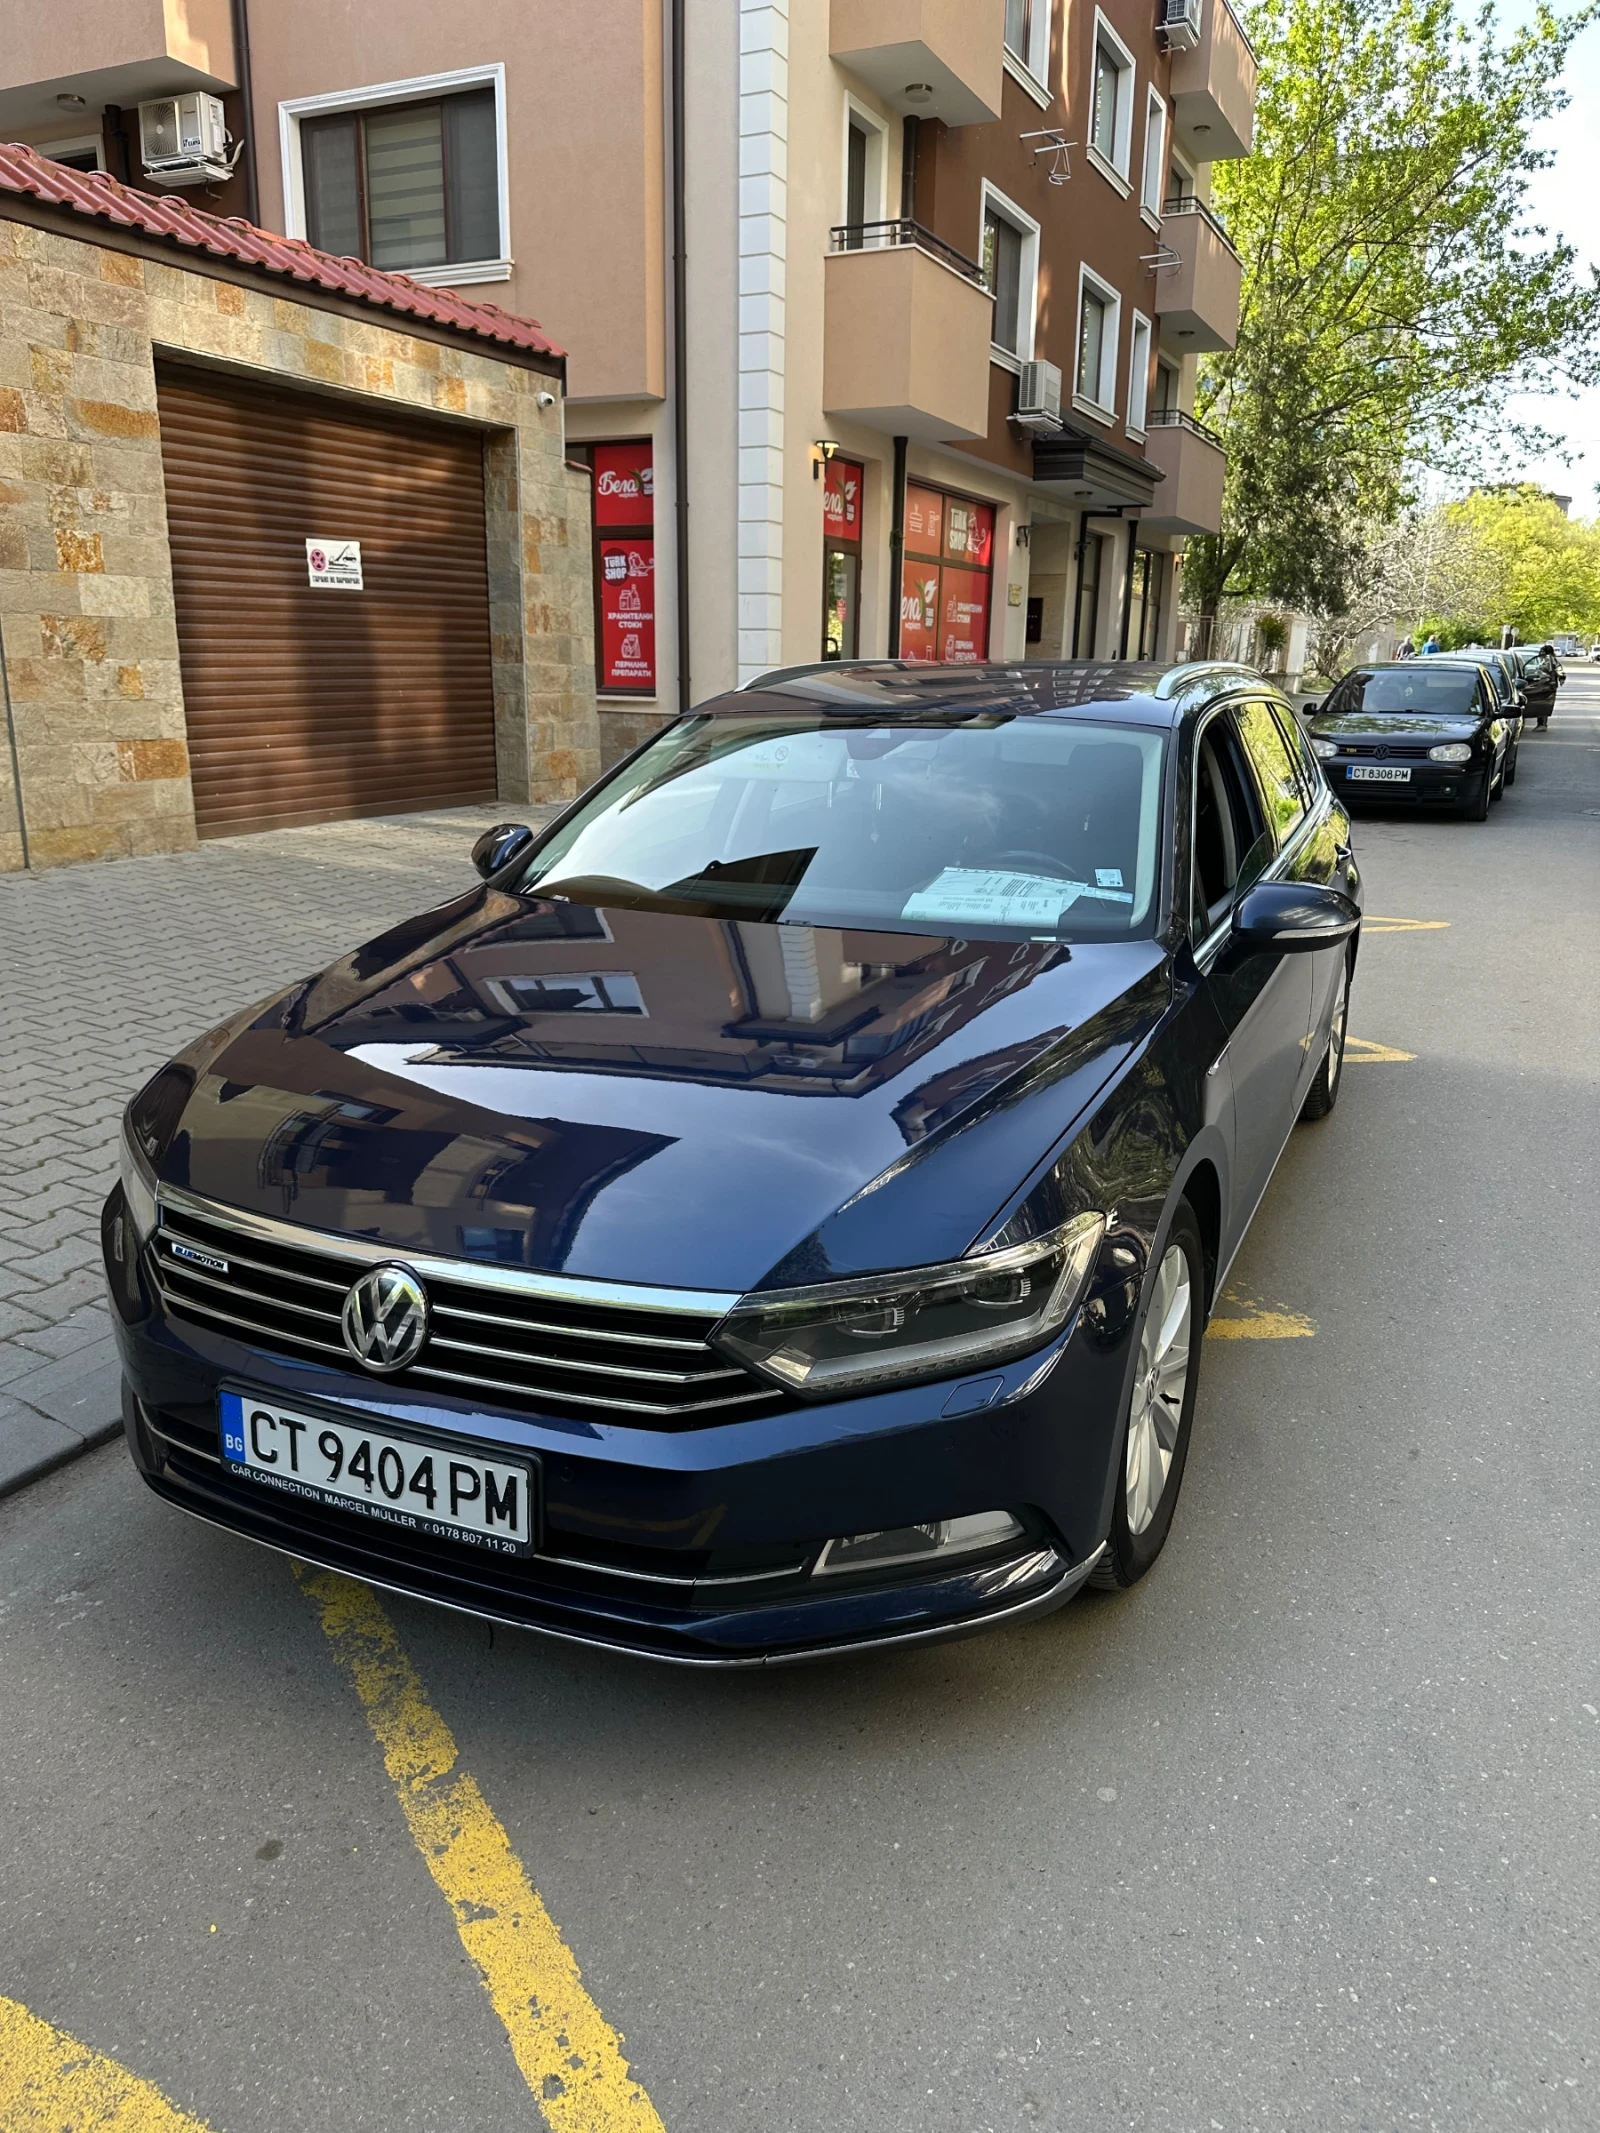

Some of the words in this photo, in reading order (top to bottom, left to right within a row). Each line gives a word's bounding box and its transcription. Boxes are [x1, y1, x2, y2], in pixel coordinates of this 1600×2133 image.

[598, 470, 638, 496] Бела
[824, 491, 843, 514] ела
[950, 530, 966, 551] SHOP
[605, 568, 627, 580] SHOP
[608, 612, 653, 620] ХРАНИТЕЛНИ
[901, 596, 922, 620] ела
[618, 621, 643, 629] СТОКИ
[612, 669, 652, 677] ПРЕПАРАТИ
[1369, 769, 1393, 779] 8308
[175, 1246, 224, 1270] BLUEMOTION
[225, 1433, 243, 1452] BG
[250, 1410, 307, 1472] CT
[318, 1429, 438, 1511] 9404
[449, 1461, 518, 1531] PM
[230, 1463, 252, 1480] CAR
[253, 1470, 321, 1500] CONNECTION
[324, 1493, 370, 1515] MARCEL
[371, 1505, 417, 1528] MÜLLER
[432, 1524, 460, 1541] 0178
[462, 1530, 482, 1545] 807
[486, 1536, 498, 1550] 11
[502, 1540, 516, 1554] 20
